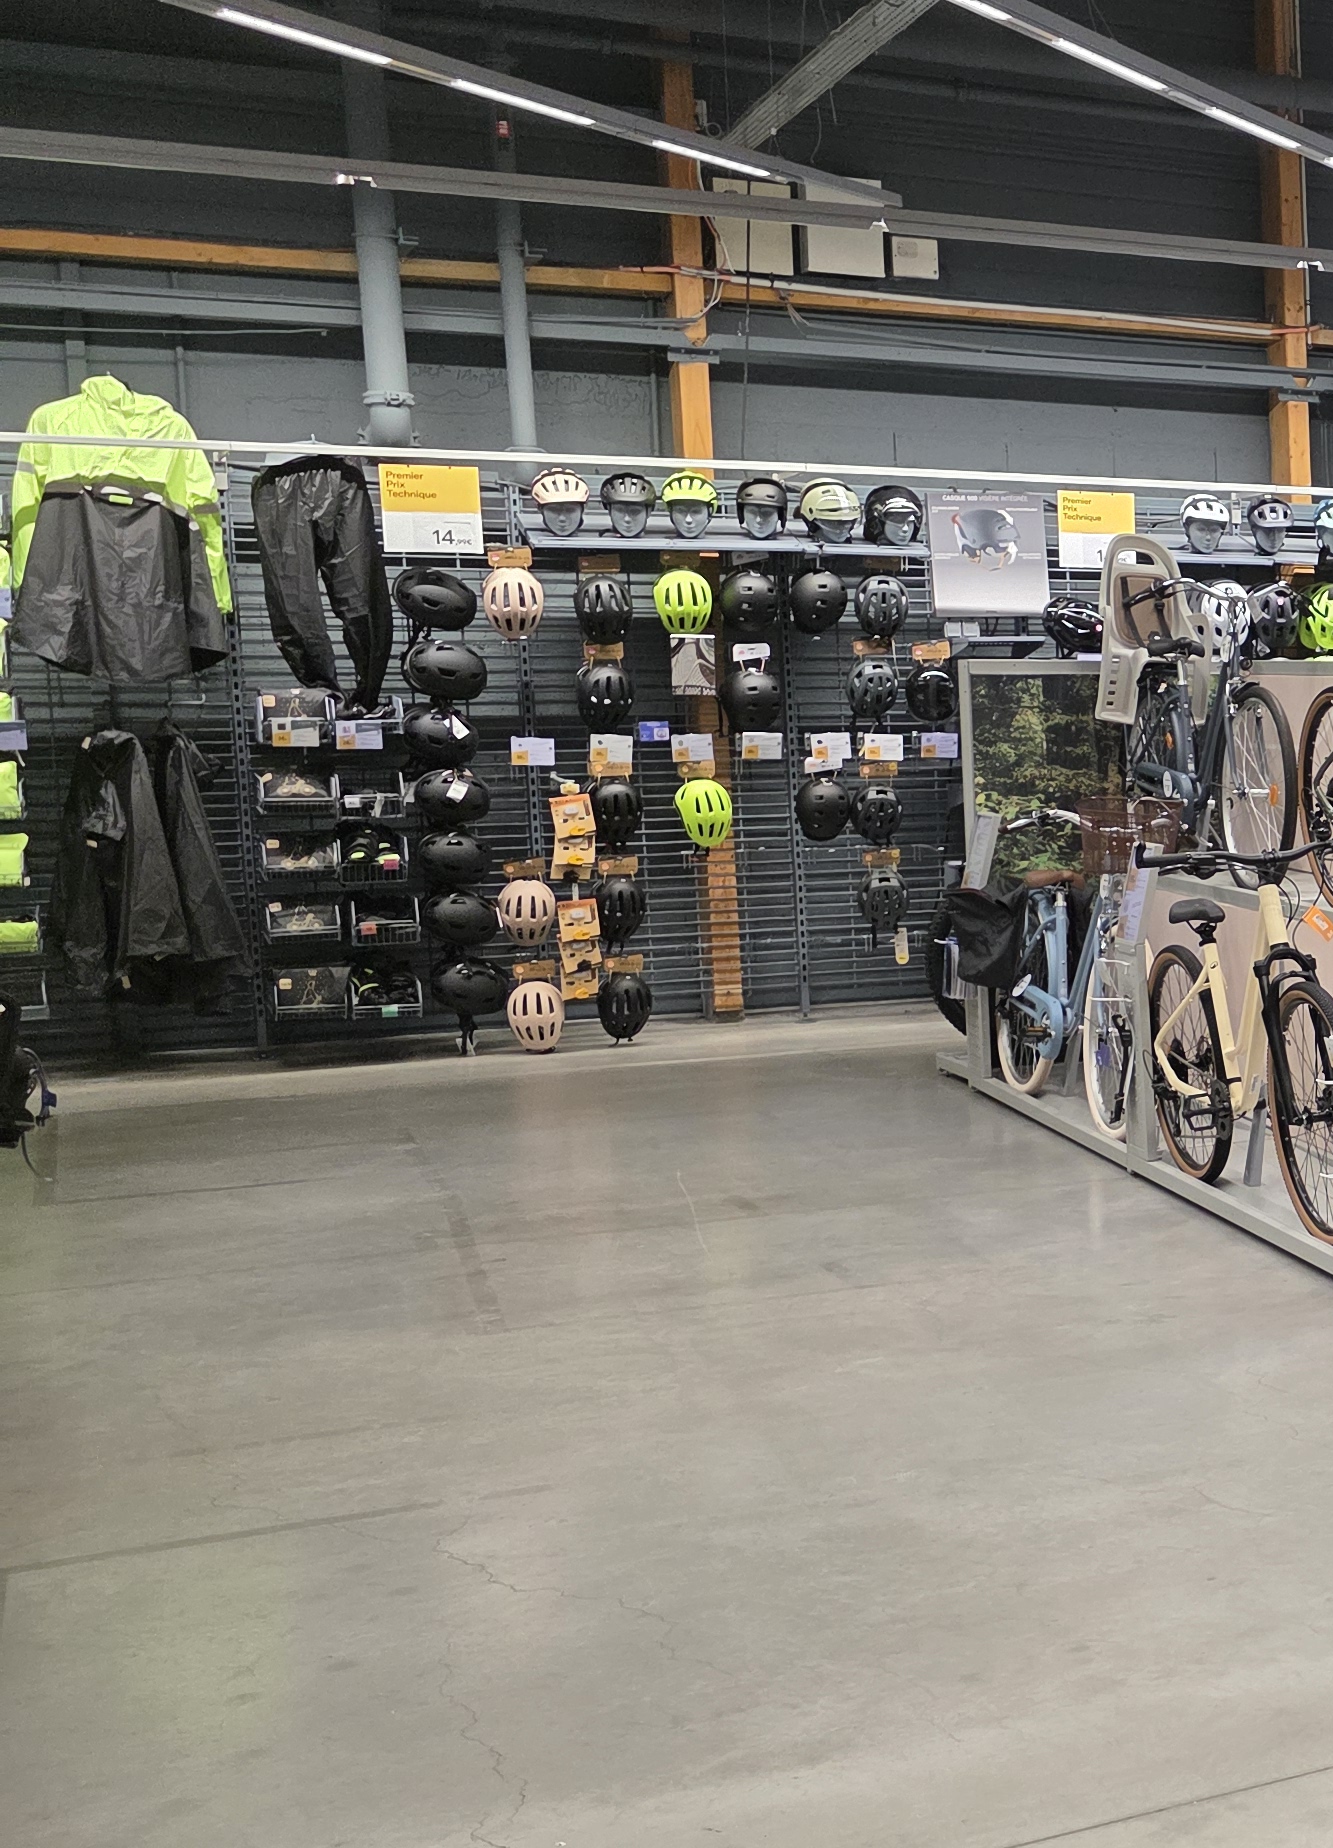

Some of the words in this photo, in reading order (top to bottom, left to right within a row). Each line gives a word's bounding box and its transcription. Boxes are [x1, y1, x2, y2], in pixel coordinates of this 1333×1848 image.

[385, 471, 424, 480] Premier
[386, 480, 405, 488] Prix
[387, 489, 437, 500] Technique
[1062, 496, 1092, 505] Premier
[1063, 513, 1102, 522] Technique
